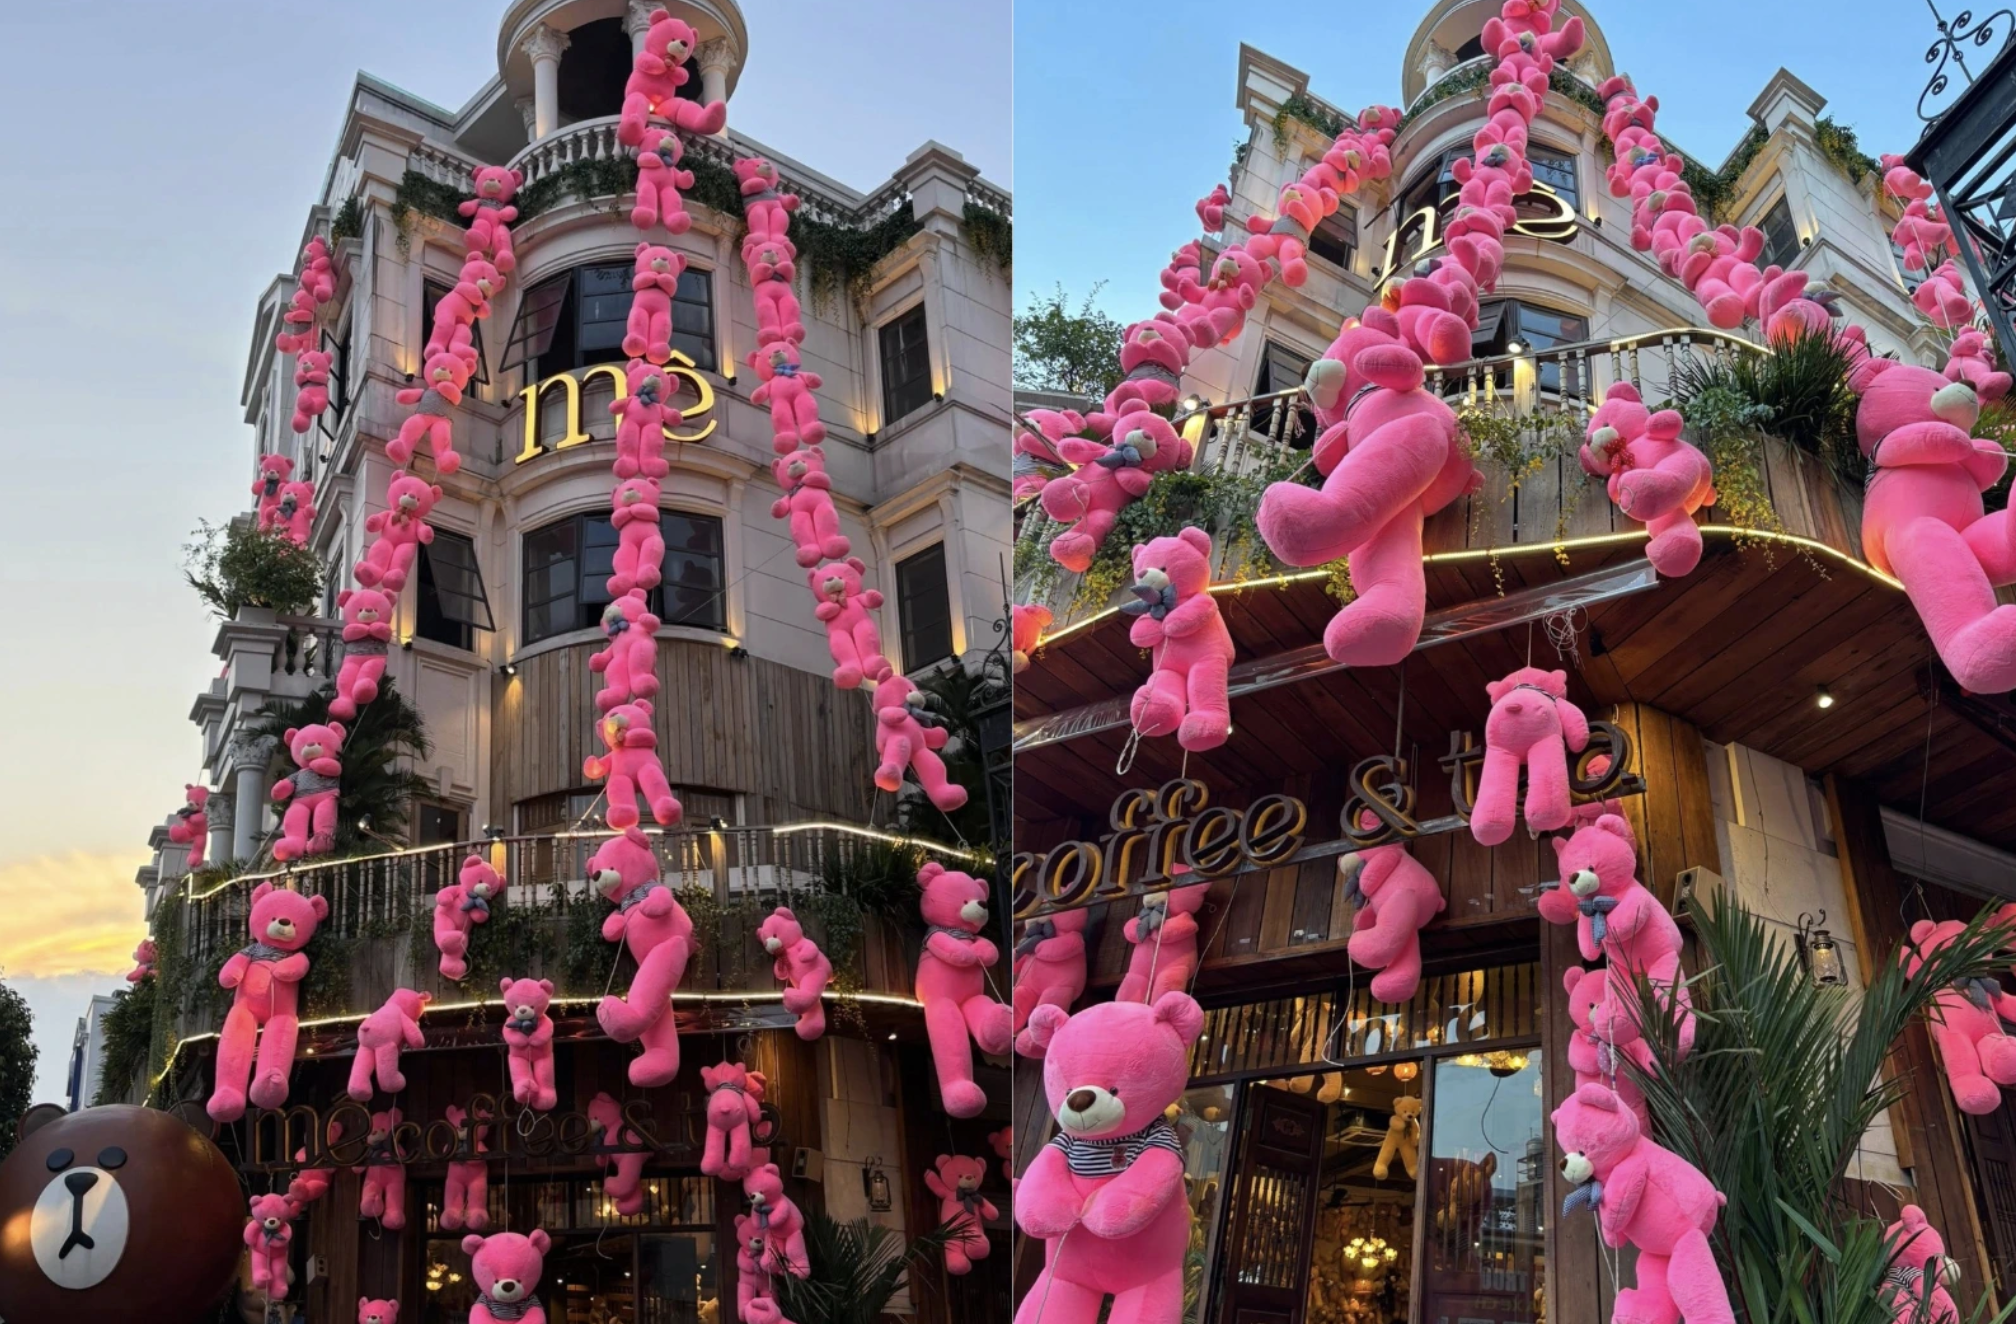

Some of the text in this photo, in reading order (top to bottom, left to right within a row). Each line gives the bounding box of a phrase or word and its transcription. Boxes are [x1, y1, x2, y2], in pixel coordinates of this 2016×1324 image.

[1340, 754, 1422, 846] &
[1437, 721, 1640, 822] ta
[391, 1093, 592, 1164] coffee
[618, 1097, 664, 1151] &
[681, 1093, 785, 1146] ta
